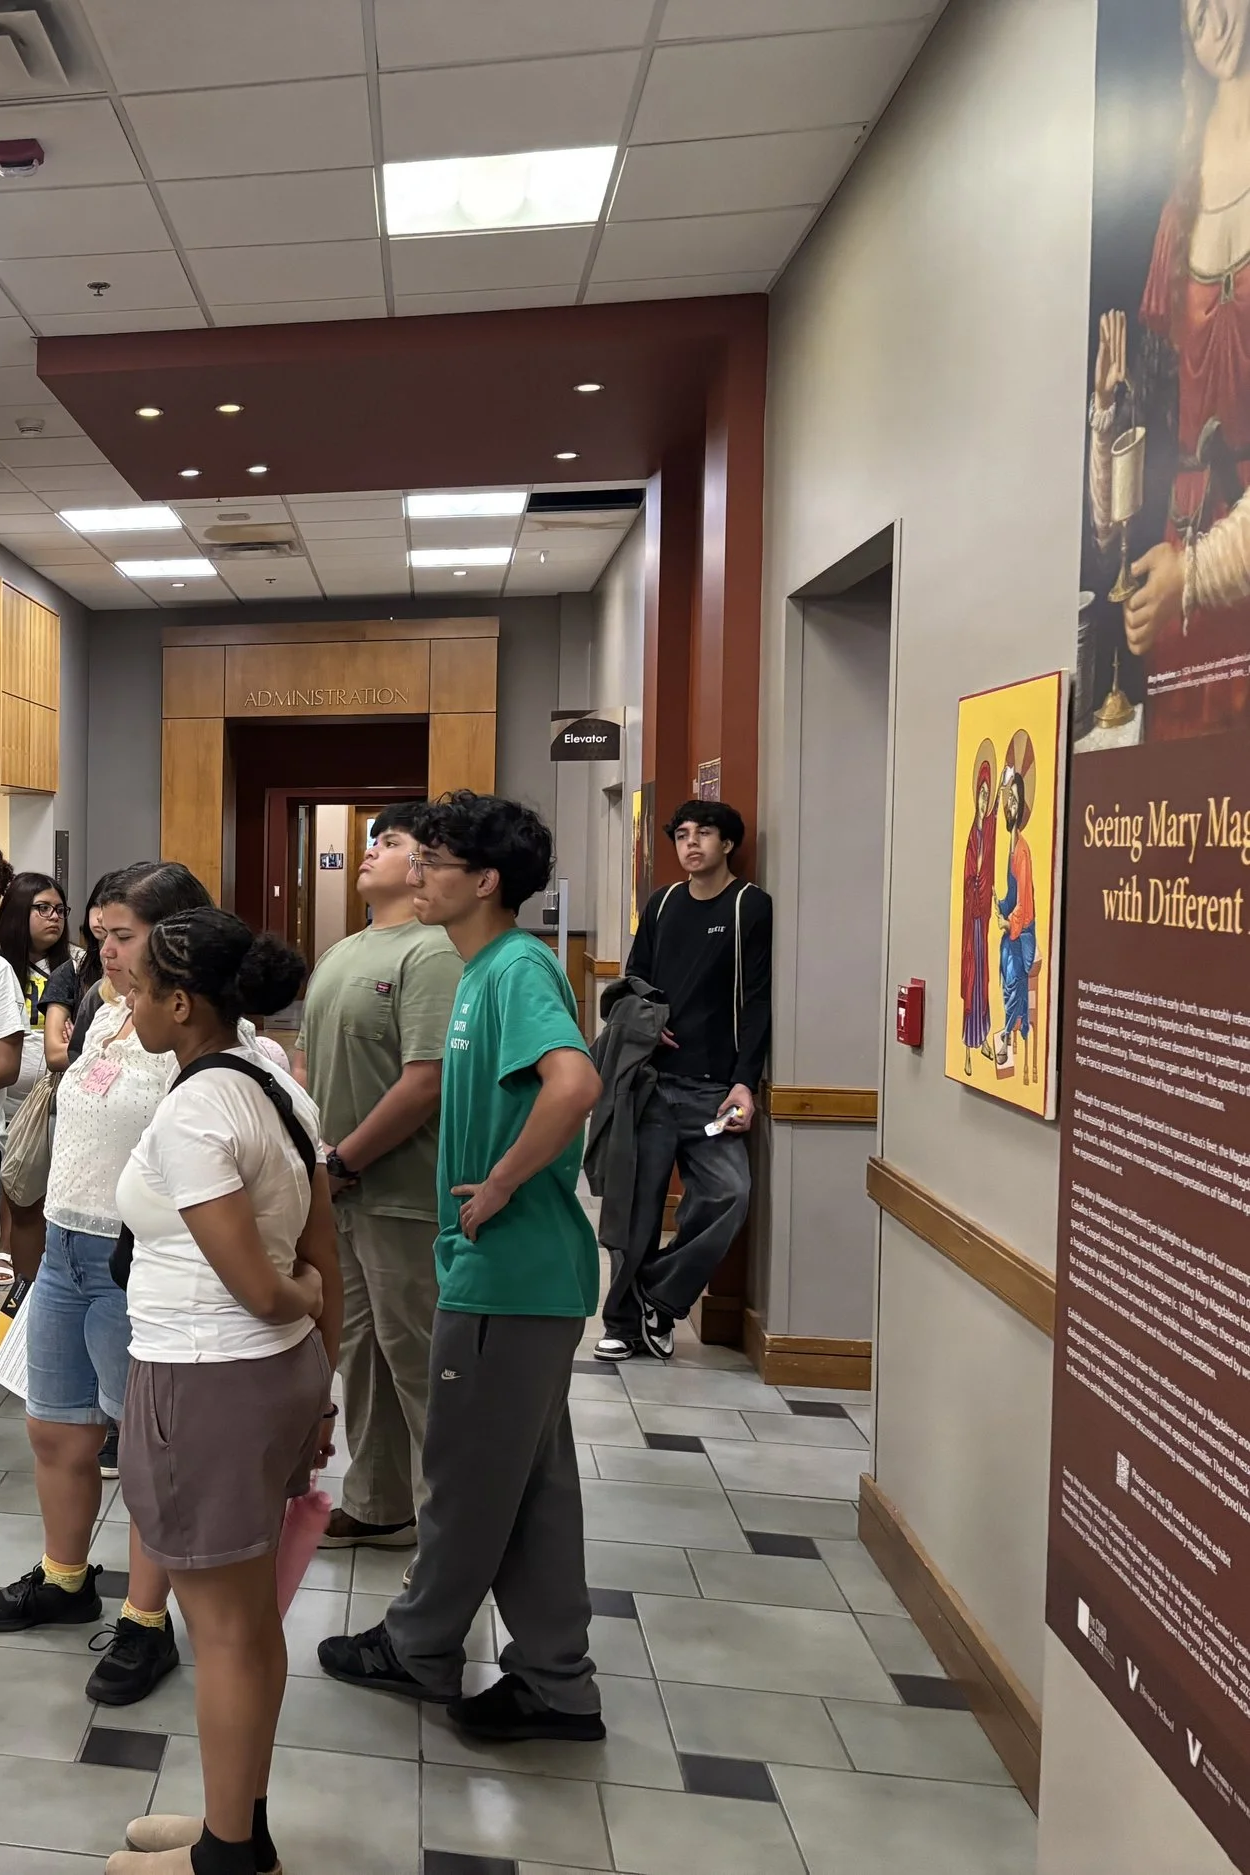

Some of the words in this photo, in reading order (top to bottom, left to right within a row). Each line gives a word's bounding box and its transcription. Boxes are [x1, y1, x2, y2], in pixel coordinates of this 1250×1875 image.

[244, 687, 409, 707] ADMINISTRATION
[564, 733, 608, 744] Elevator
[1084, 803, 1143, 863] Seeing
[1148, 801, 1202, 863] Mary
[1102, 874, 1143, 923] with
[1147, 877, 1243, 934] Different
